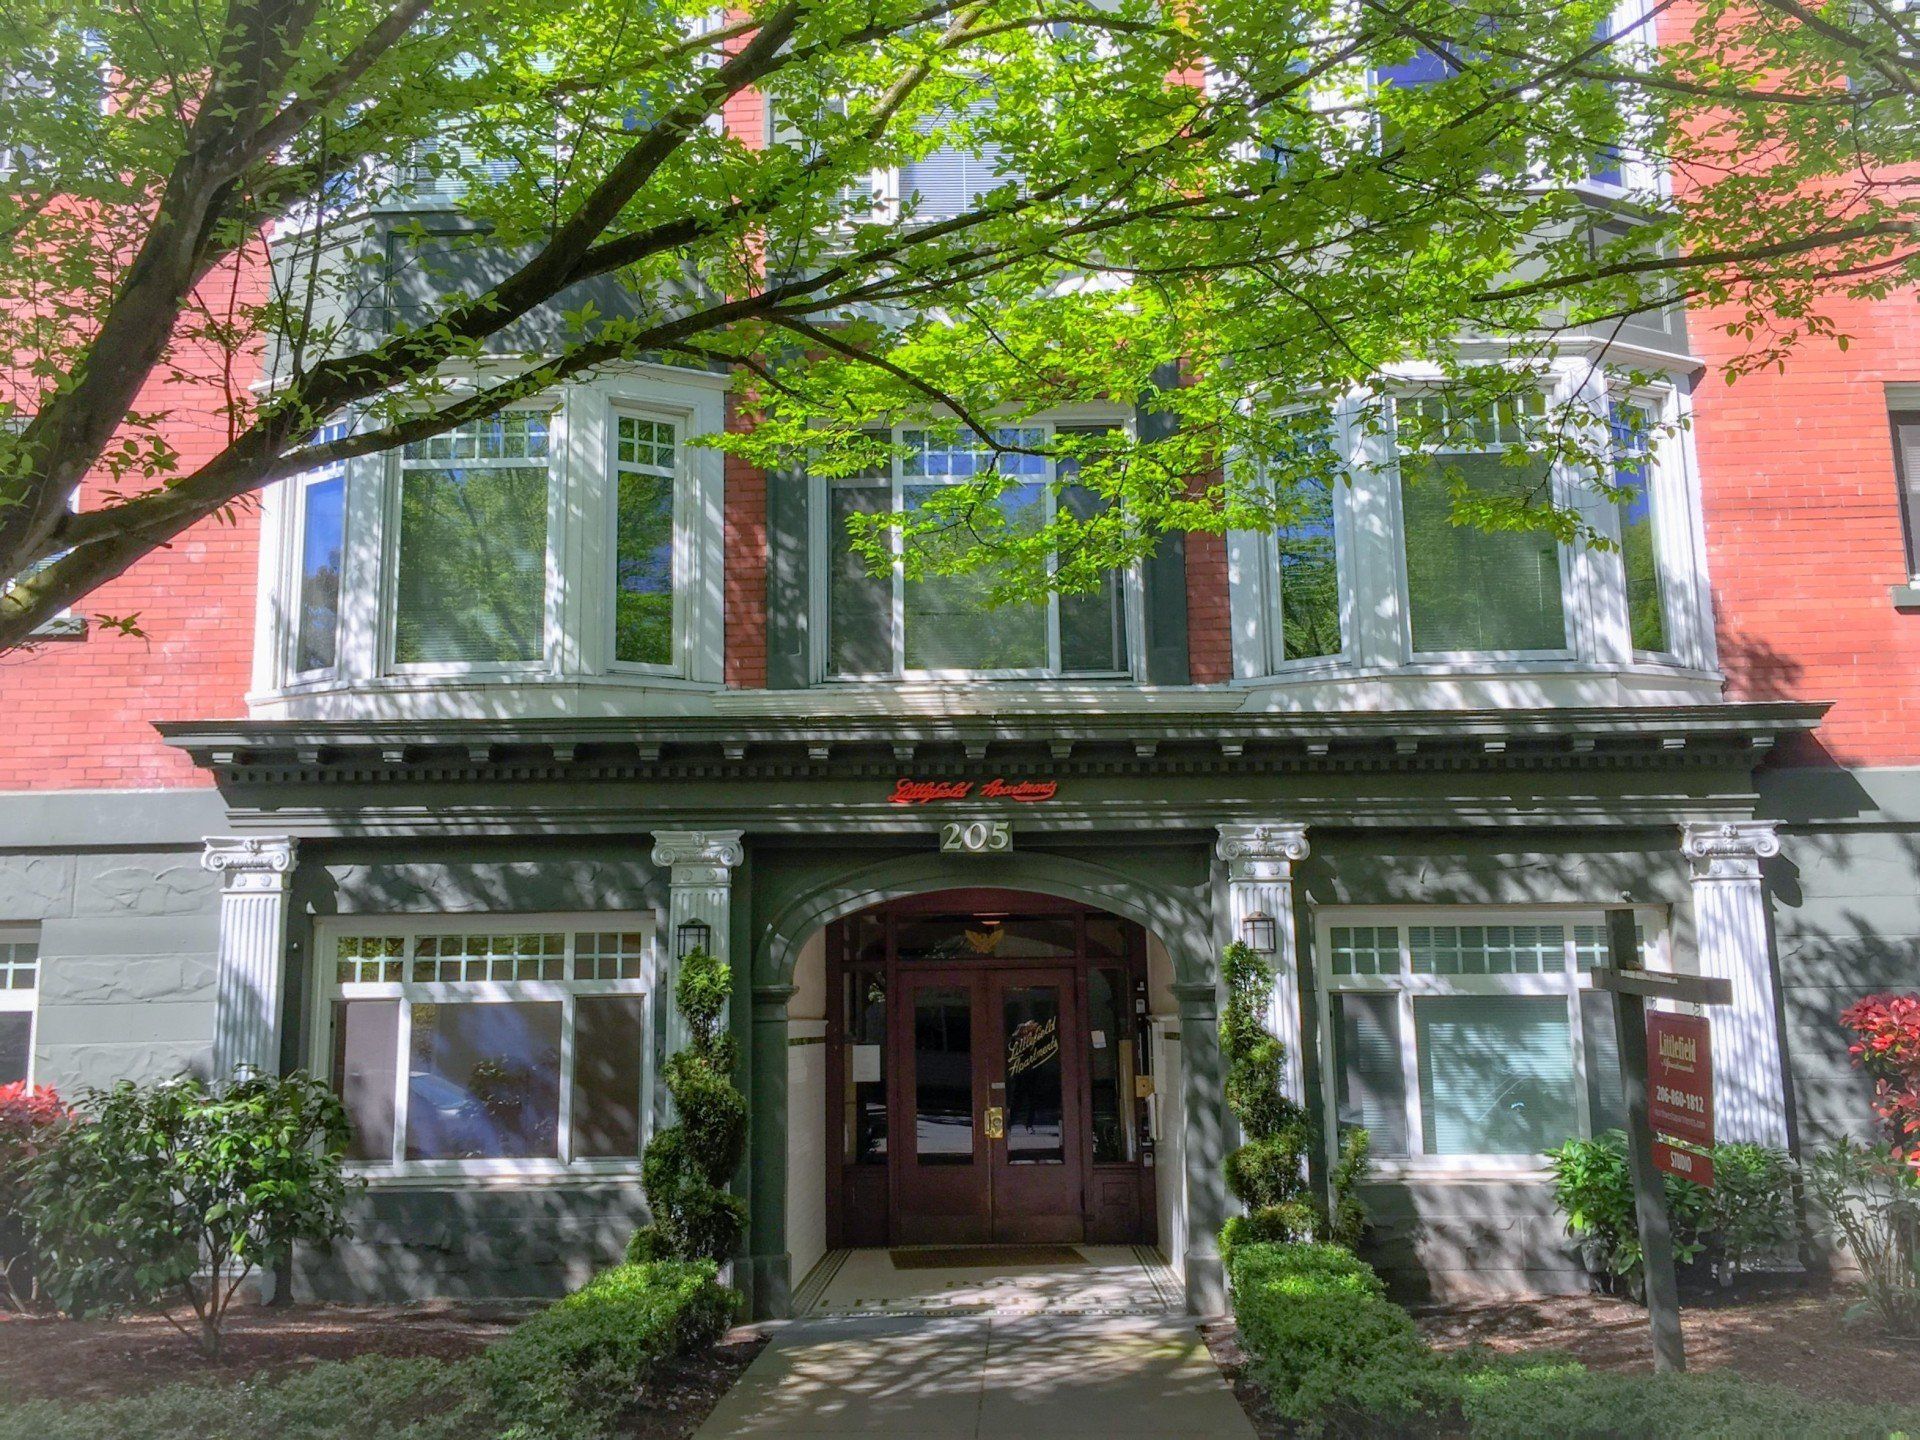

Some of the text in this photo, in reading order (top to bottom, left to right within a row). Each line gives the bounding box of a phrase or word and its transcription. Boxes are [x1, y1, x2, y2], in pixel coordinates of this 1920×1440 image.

[887, 778, 1058, 804] Littlefield Apartments
[942, 822, 1010, 850] 205
[1008, 1016, 1056, 1062] Littlefield
[1659, 1030, 1697, 1062] Littlefield
[1008, 1035, 1059, 1077] Apartments
[1670, 1151, 1692, 1173] STUDIO
